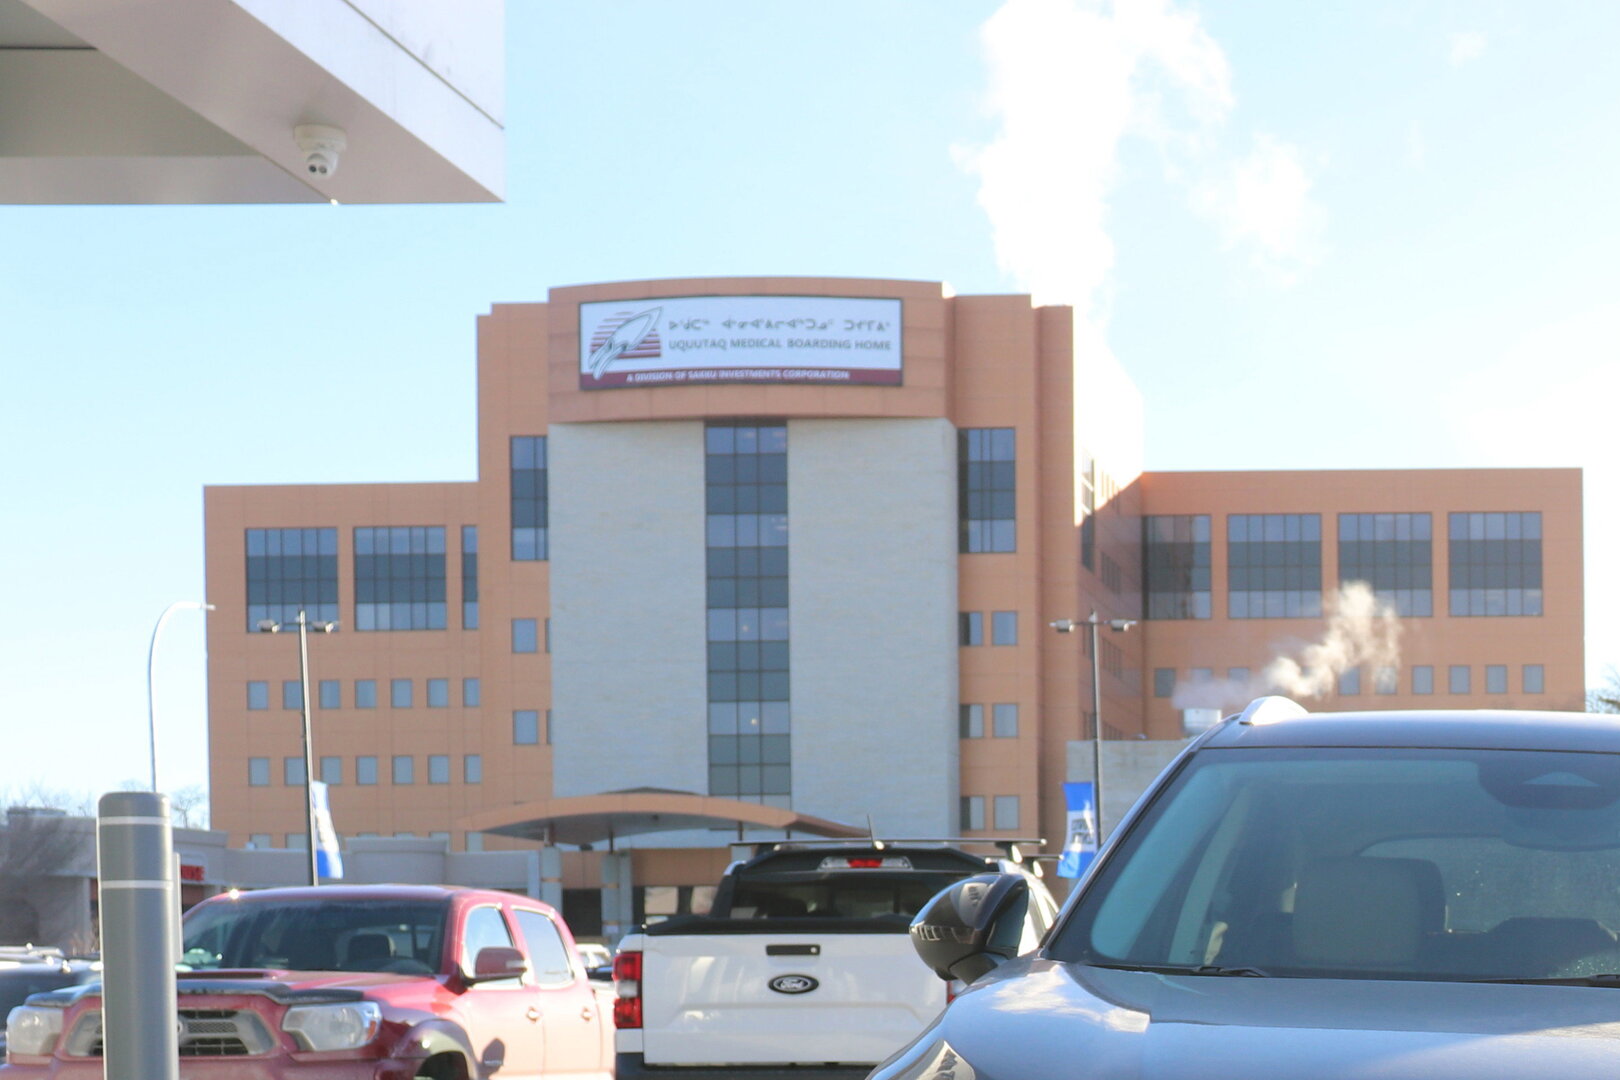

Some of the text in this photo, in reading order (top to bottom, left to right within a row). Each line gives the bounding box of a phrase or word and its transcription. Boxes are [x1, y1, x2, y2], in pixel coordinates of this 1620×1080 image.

[668, 338, 891, 352] UQUUTAQ MEDICAL BOARDING HOME
[626, 373, 633, 384] A
[634, 371, 673, 384] DIVISION
[674, 370, 686, 382] OF
[718, 368, 782, 380] INVESTMENTS
[783, 368, 850, 380] CORPORATION
